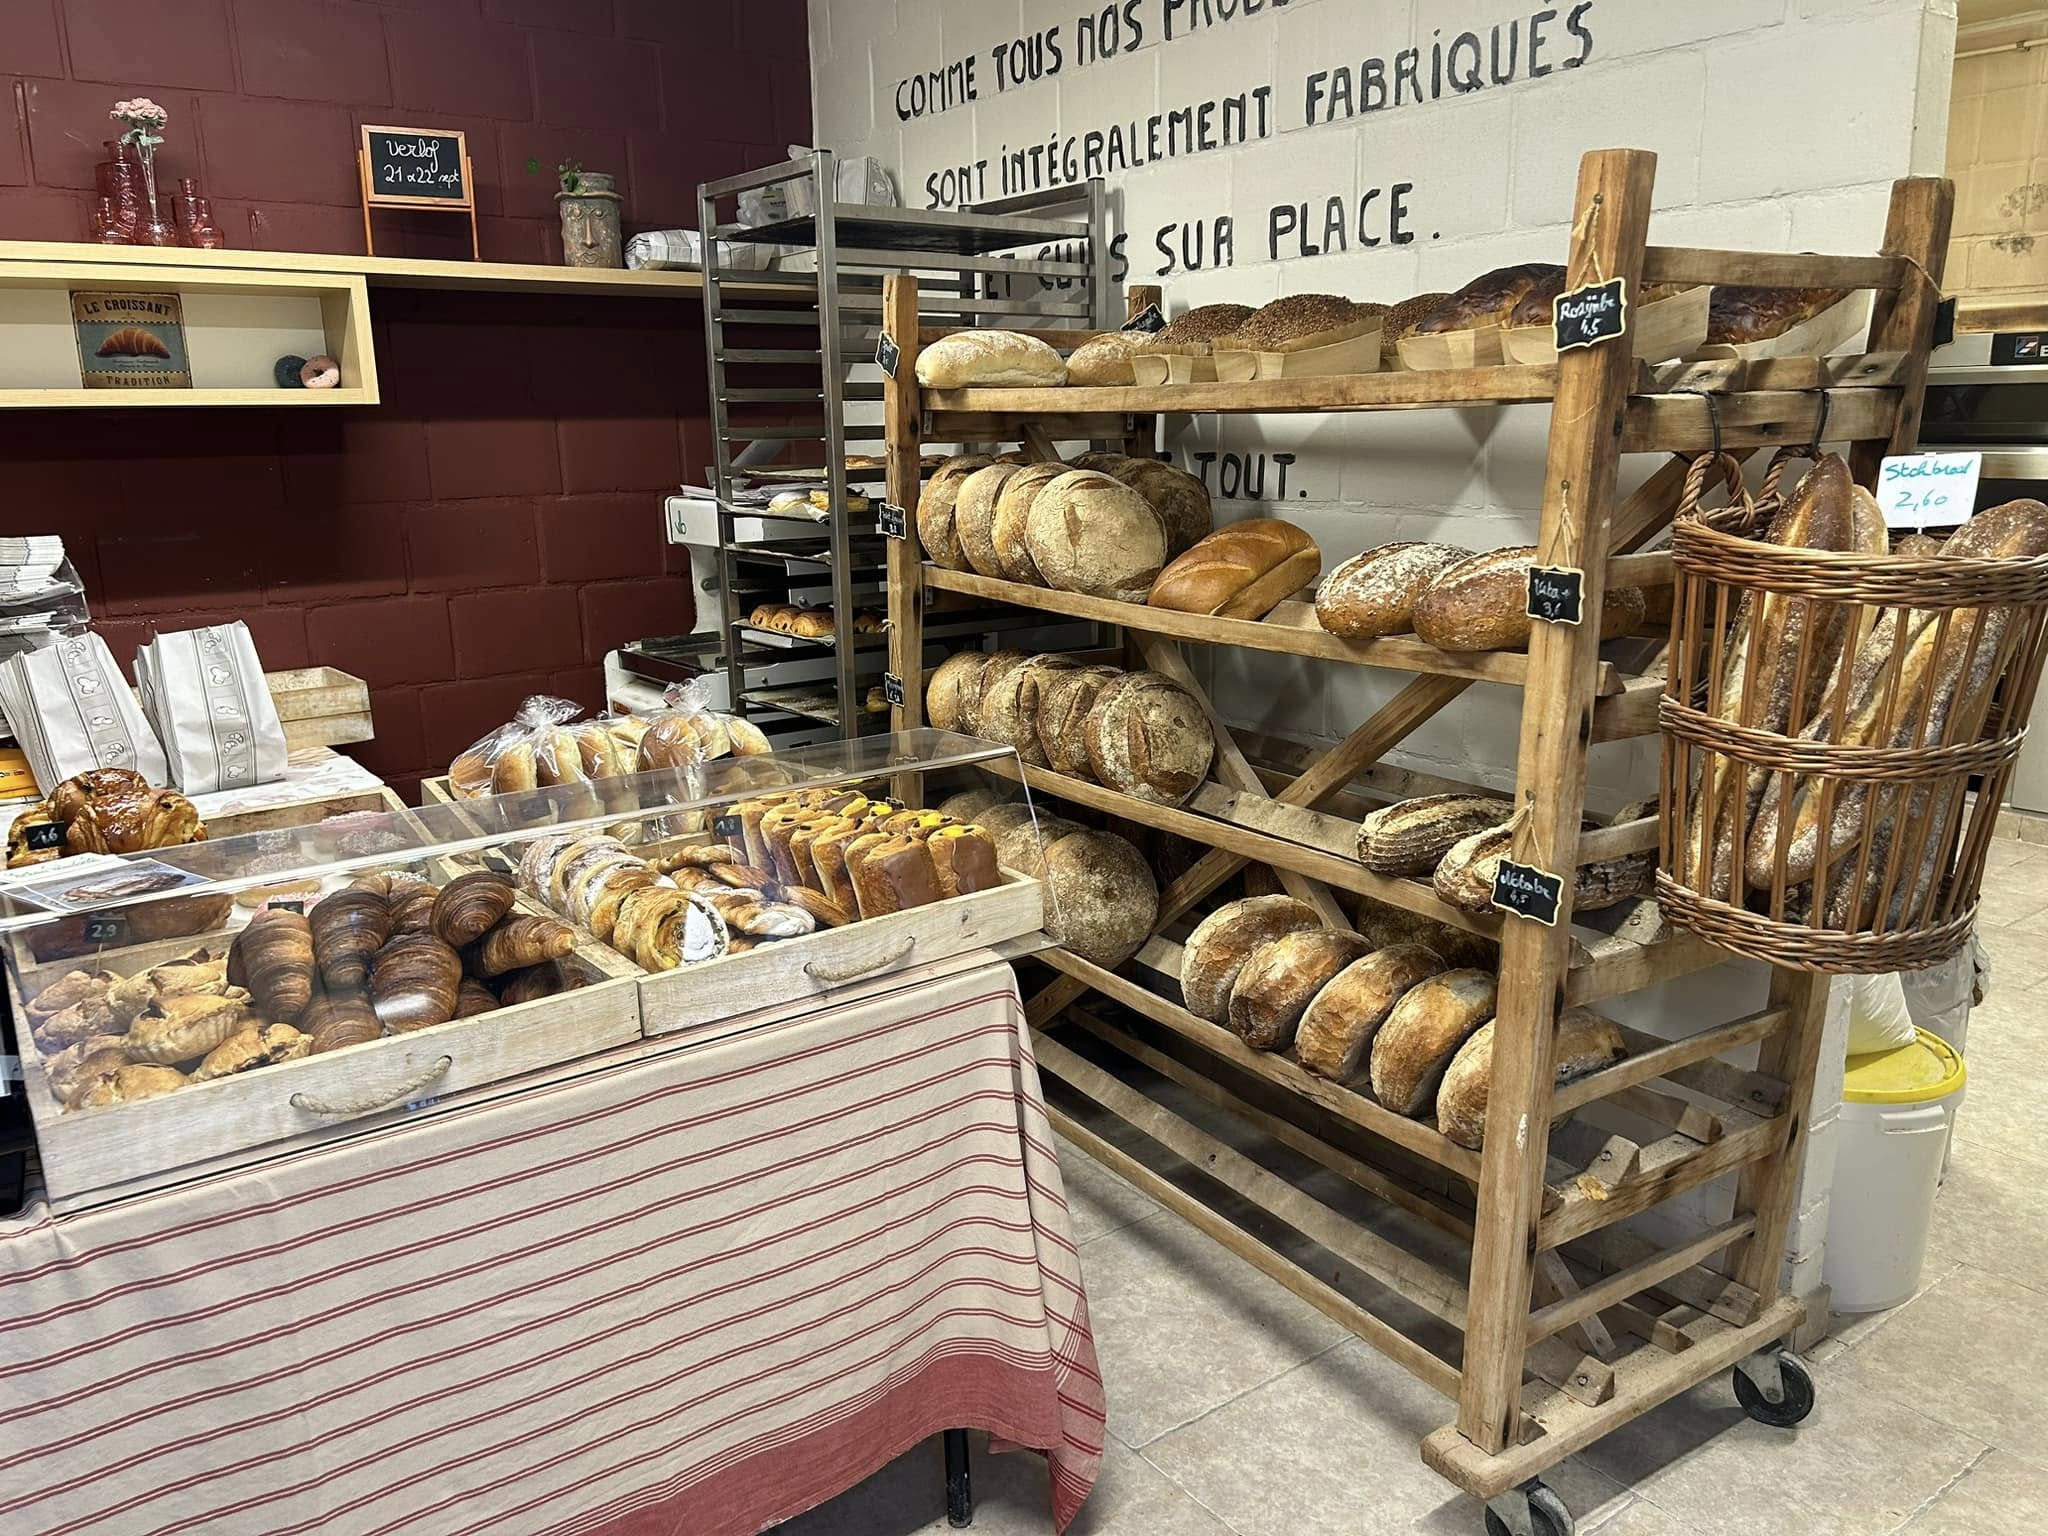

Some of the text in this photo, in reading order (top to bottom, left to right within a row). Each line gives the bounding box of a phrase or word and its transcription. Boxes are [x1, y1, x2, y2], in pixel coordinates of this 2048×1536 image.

[895, 55, 979, 122] COMME
[992, 25, 1062, 93] TOUS
[1077, 0, 1143, 66] NOS
[384, 164, 402, 183] 21
[416, 166, 435, 184] 22
[926, 159, 988, 211] SONT
[1037, 232, 1129, 291] CUIS
[1268, 182, 1440, 261] PLACE.
[83, 298, 172, 317] LE CROISSANT
[105, 375, 172, 387] TRADITION
[1193, 452, 1308, 501] TOUT.
[1895, 488, 1949, 512] 2,60
